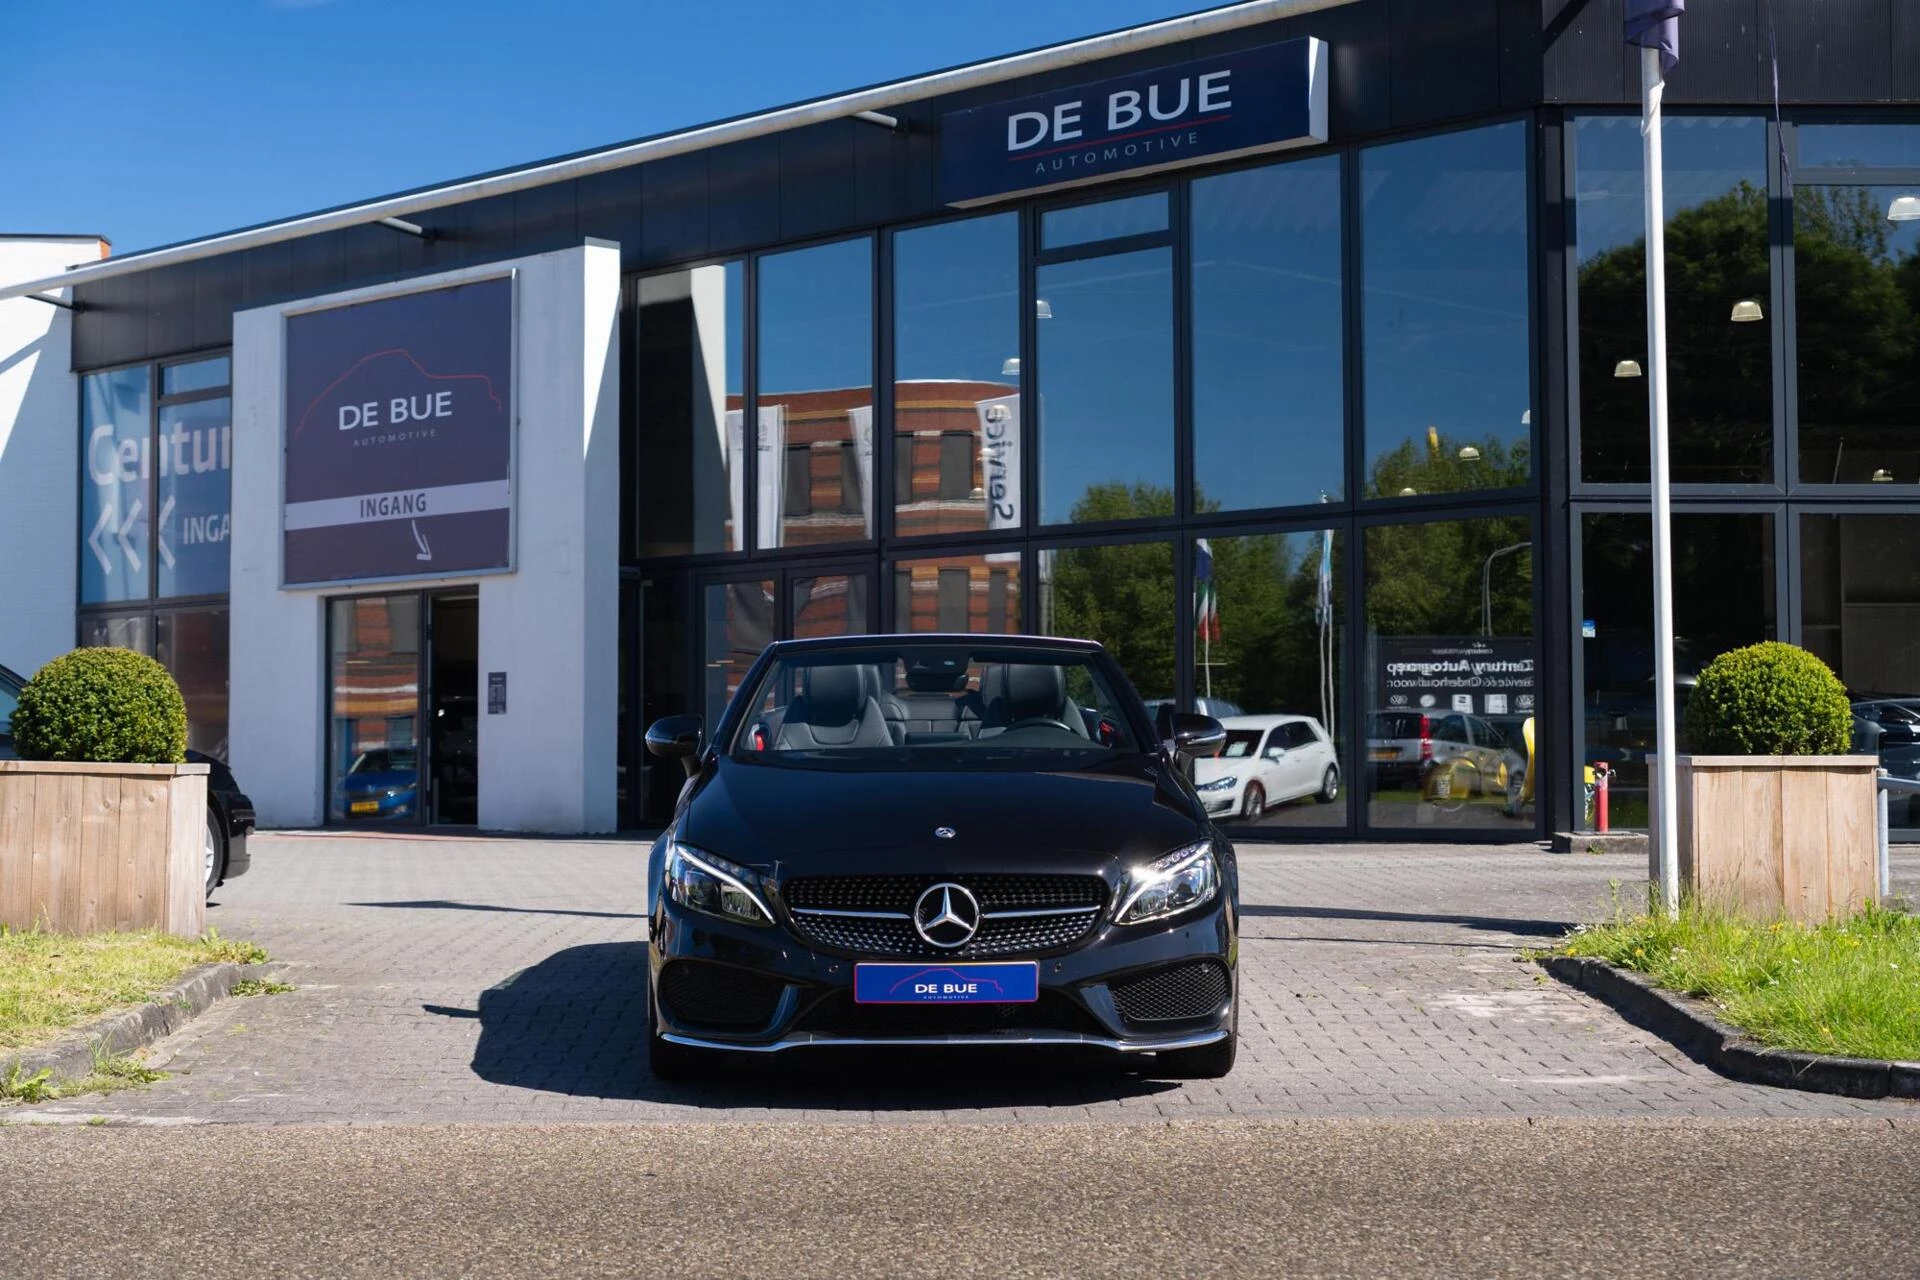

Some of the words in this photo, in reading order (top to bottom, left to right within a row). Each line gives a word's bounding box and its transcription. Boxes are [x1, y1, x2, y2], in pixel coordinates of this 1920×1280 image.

[1007, 100, 1083, 151] DE
[1107, 70, 1233, 131] BUE
[1034, 131, 1199, 175] AUTOMOTIVE
[339, 401, 379, 431] DE
[390, 391, 453, 424] BUE
[353, 428, 437, 447] AUTOMOTIVE
[360, 493, 427, 519] INGANG
[914, 984, 938, 994] DE
[943, 983, 978, 994] BUE
